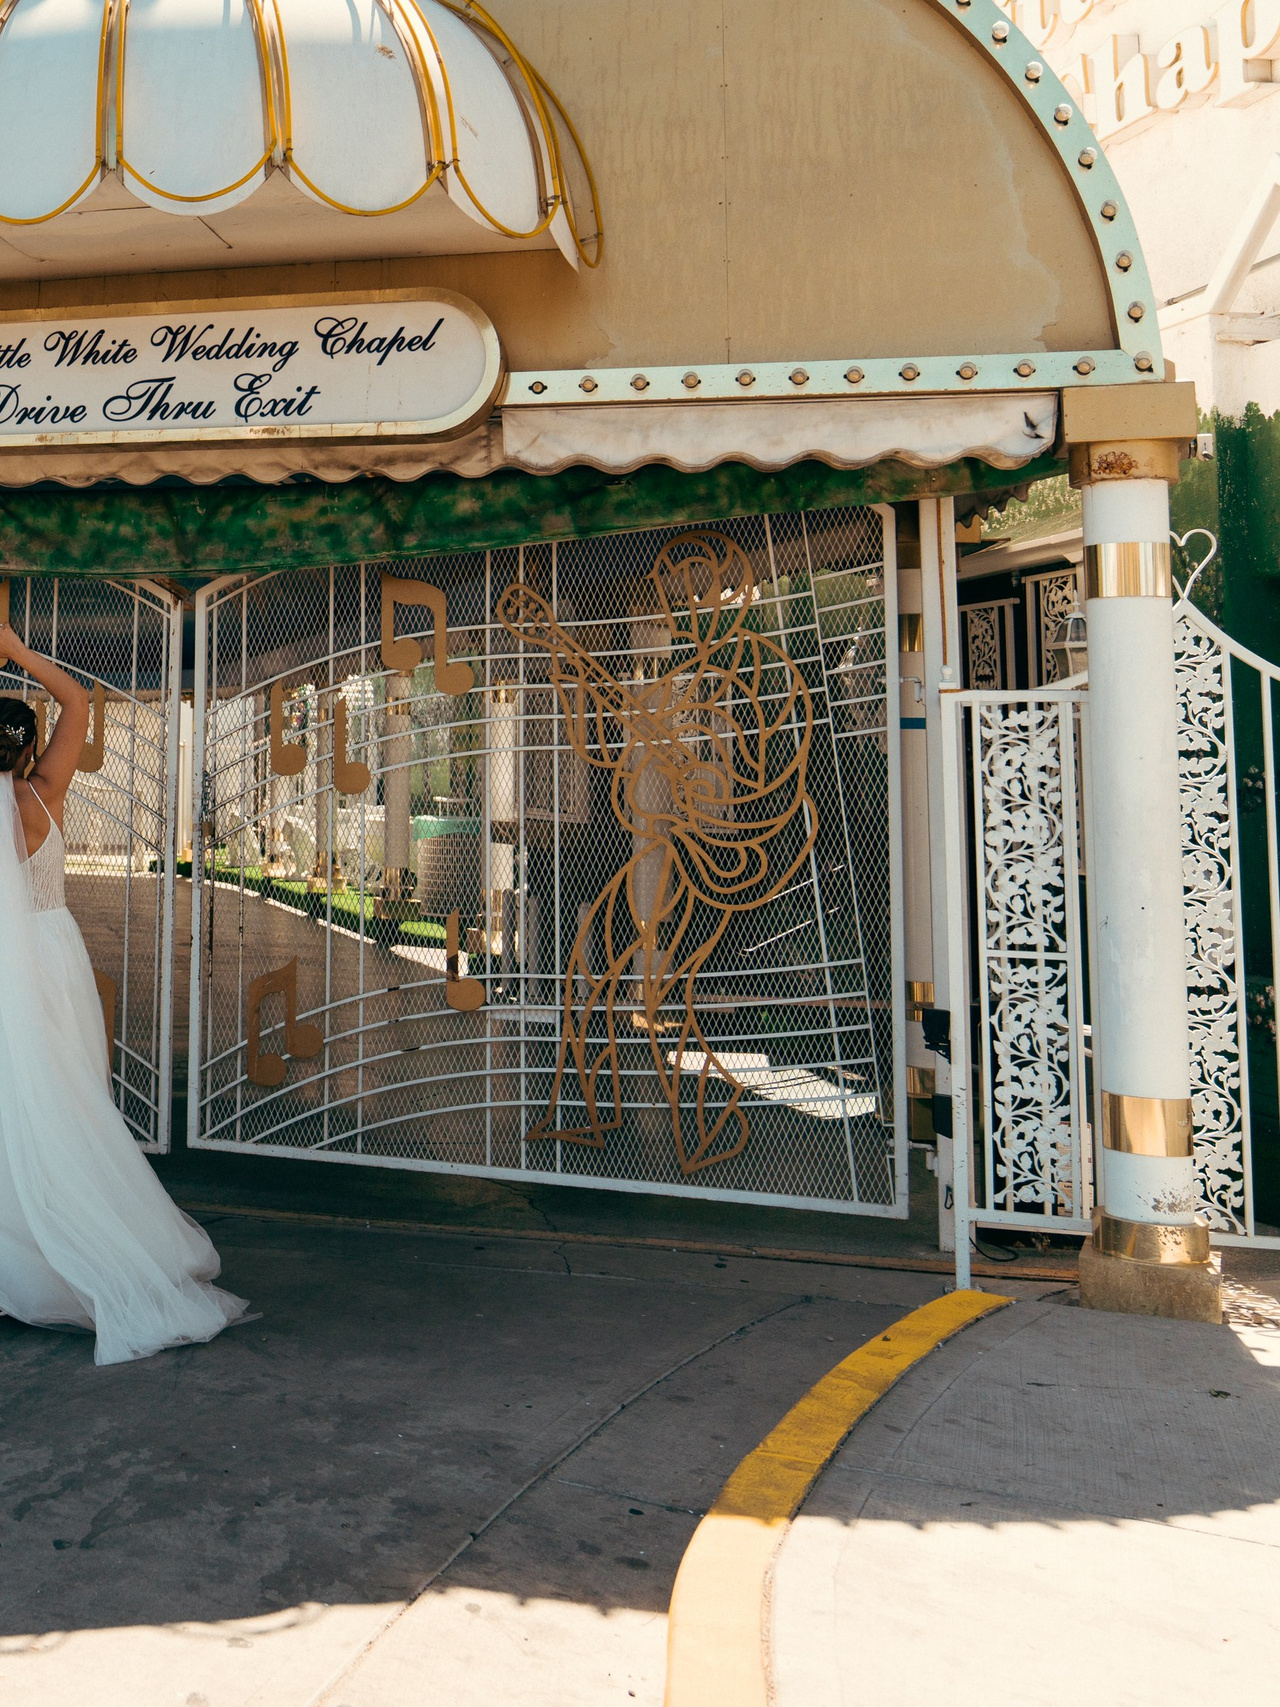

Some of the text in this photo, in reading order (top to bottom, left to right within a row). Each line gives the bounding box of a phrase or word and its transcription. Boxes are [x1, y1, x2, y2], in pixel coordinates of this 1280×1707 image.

[44, 329, 138, 368] White
[150, 324, 299, 372] Wedding
[314, 317, 445, 366] Chapel
[103, 377, 216, 422] Thru
[233, 373, 321, 423] Exit
